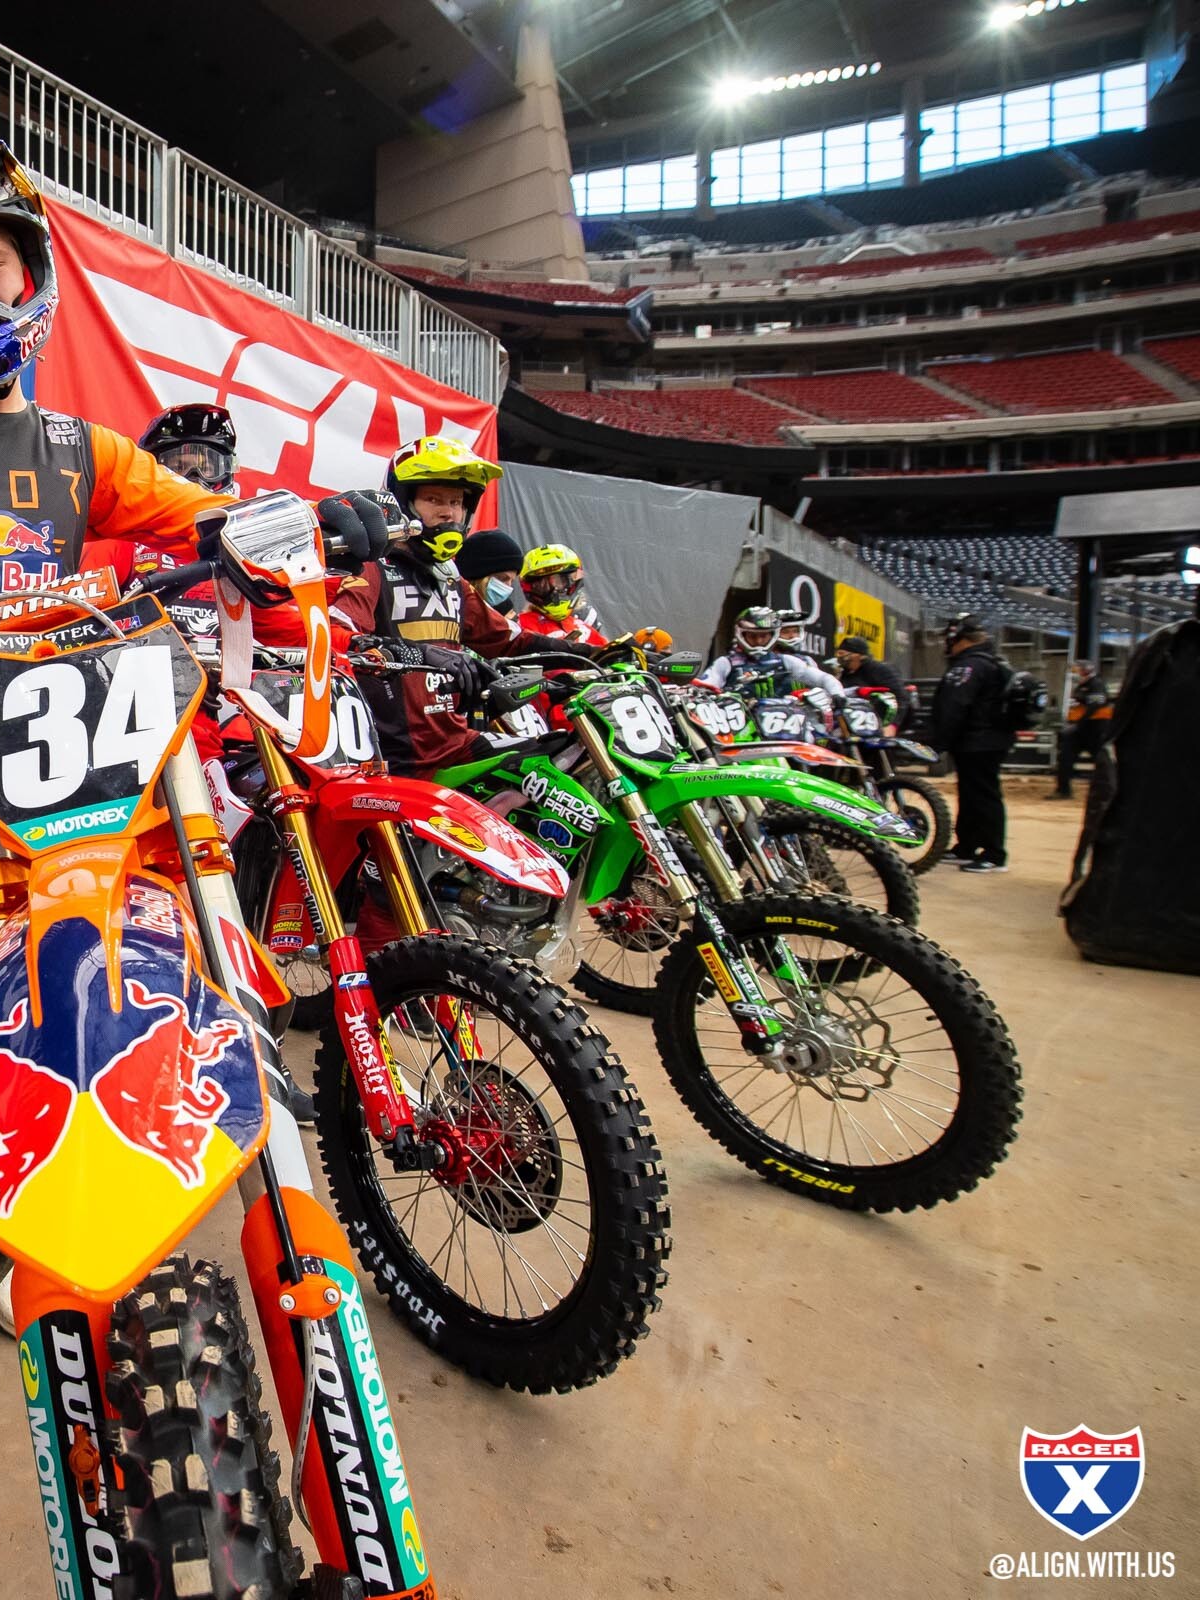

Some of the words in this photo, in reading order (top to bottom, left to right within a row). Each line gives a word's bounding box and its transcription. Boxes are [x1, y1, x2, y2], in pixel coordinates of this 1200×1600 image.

[611, 694, 676, 754] 88
[695, 702, 746, 736] 995
[760, 711, 804, 735] 64
[850, 711, 880, 731] 29
[543, 799, 595, 833] PARTS
[549, 785, 599, 818] MADD
[46, 805, 128, 836] MOTOREX
[765, 916, 793, 924] MID
[796, 917, 840, 933] SOFT
[344, 1009, 392, 1097] Hoosier
[762, 1157, 856, 1195] PIRELLI
[340, 1280, 410, 1504] MOTOREX
